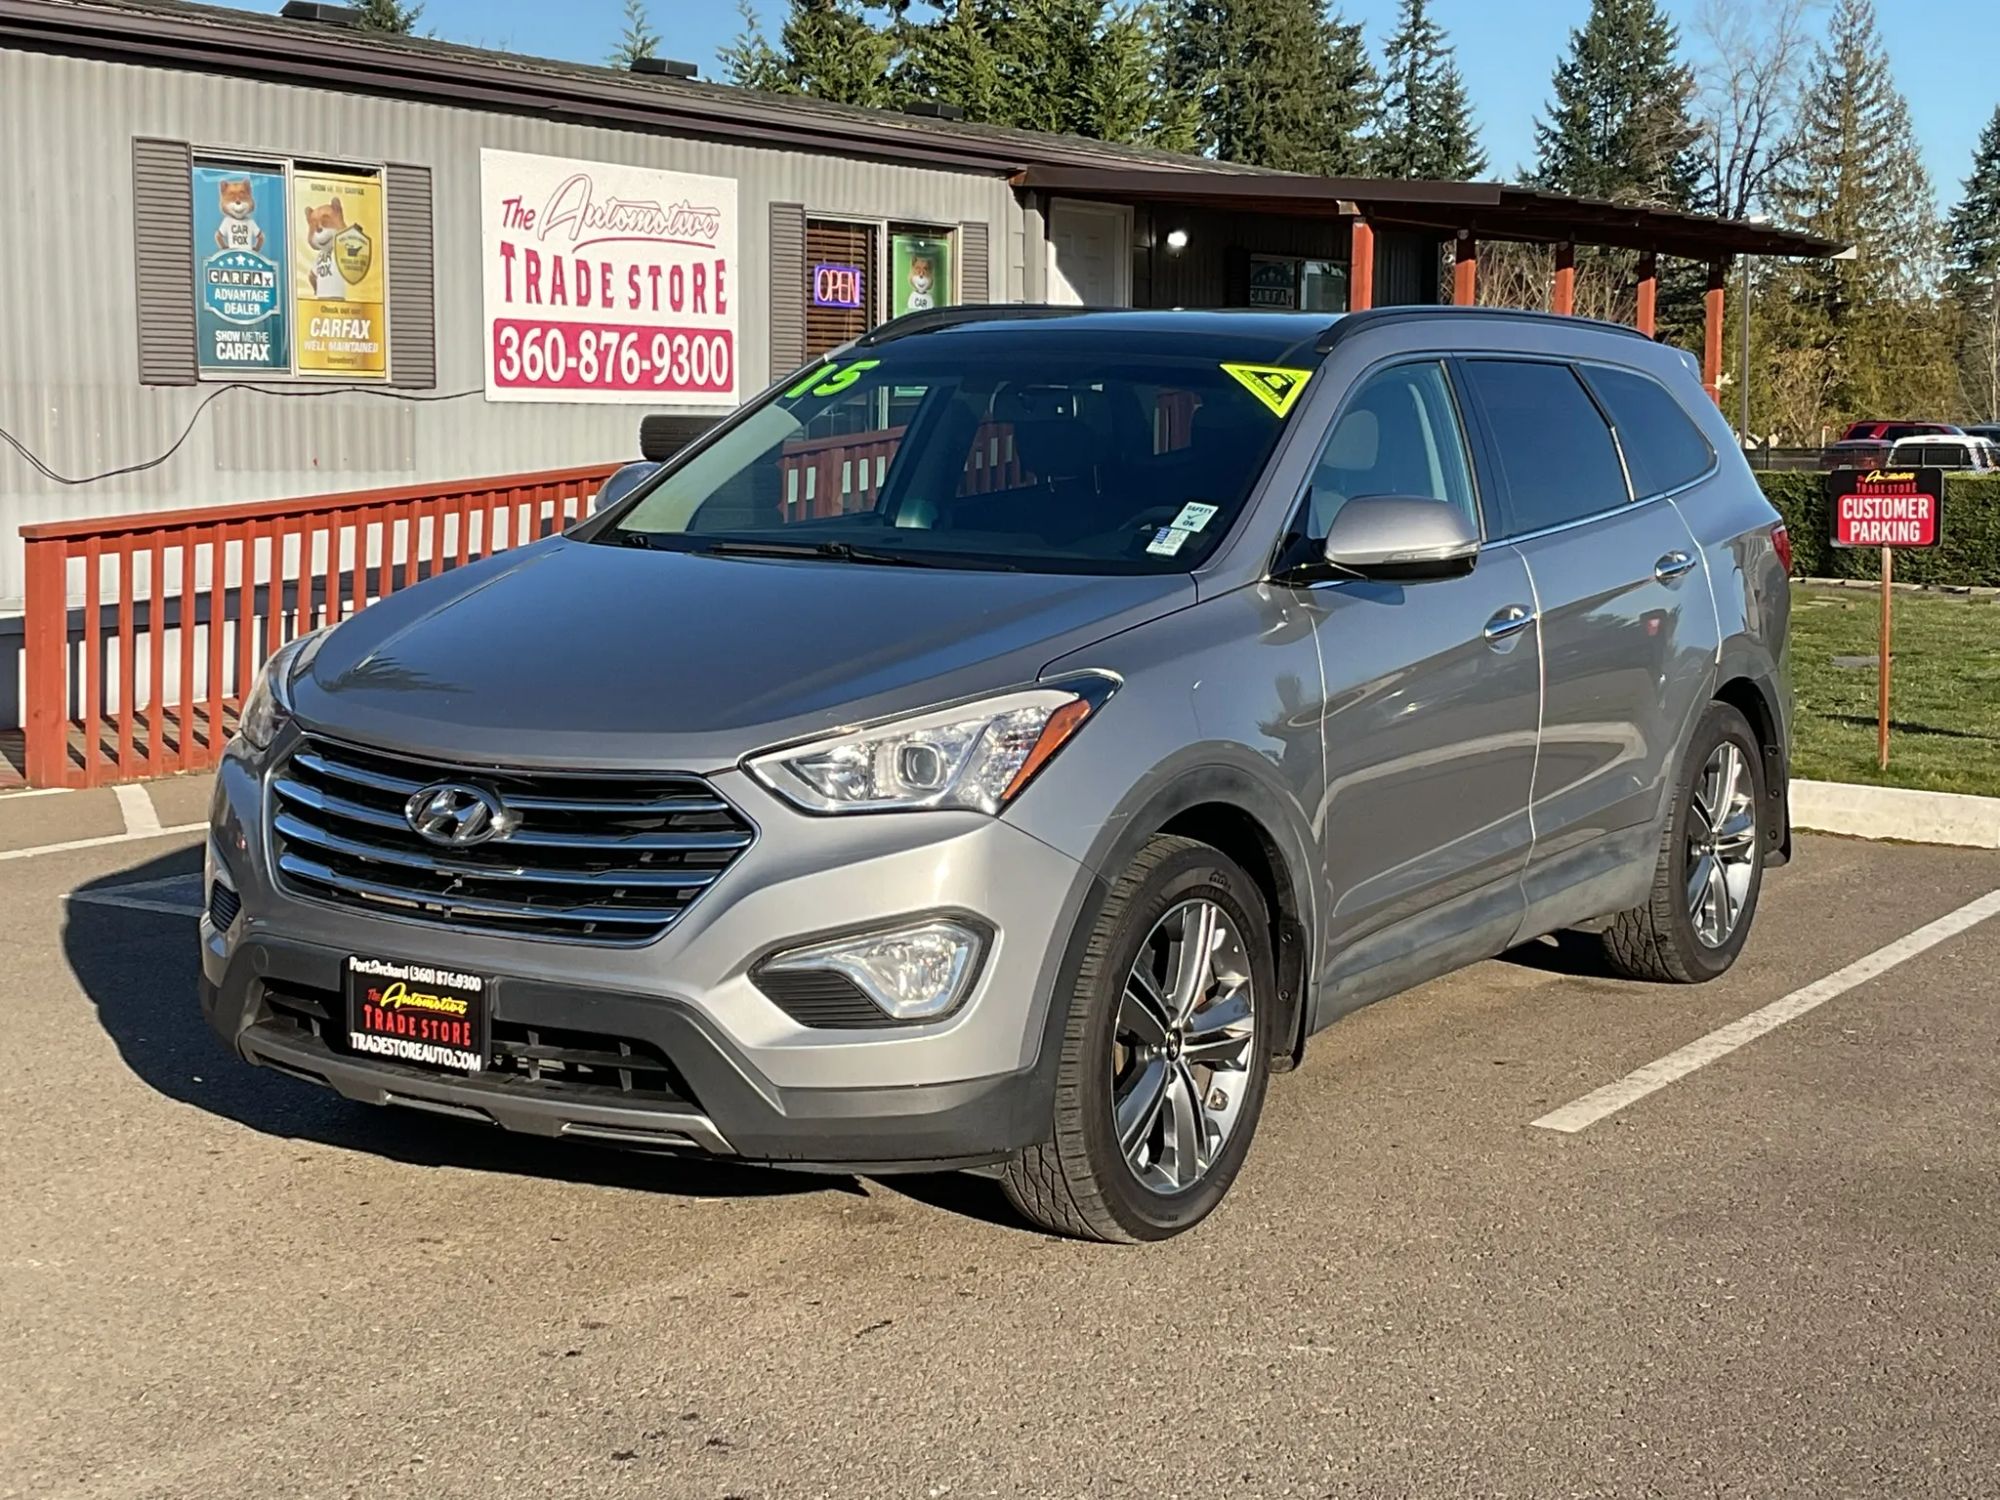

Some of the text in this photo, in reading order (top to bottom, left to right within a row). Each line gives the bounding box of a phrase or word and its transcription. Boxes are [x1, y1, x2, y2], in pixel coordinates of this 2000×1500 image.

[501, 173, 721, 241] The Automotive
[231, 224, 249, 234] CAR
[232, 235, 249, 245] FOX
[210, 270, 273, 287] CARFAX
[500, 240, 727, 315] TRADE STORE
[817, 269, 859, 303] OPEN
[214, 288, 270, 302] ADVANTAGE
[224, 302, 261, 315] DEALER
[215, 330, 269, 343] SHOW ME THE
[310, 317, 371, 339] CARFAX
[216, 342, 271, 361] CARFAX
[304, 340, 379, 353] WELL MAINTAINED
[499, 326, 729, 386] 360-876-9300
[784, 360, 881, 398] 15
[1856, 482, 1917, 494] TRADE STORE
[1186, 505, 1213, 514] SAFETY
[1842, 498, 1929, 519] CUSTOMER
[1850, 521, 1921, 542] PARKING
[349, 956, 371, 973] Port
[409, 965, 435, 985] (360)
[380, 982, 468, 1015] Automotive
[364, 1004, 471, 1046] TRADE STORE
[350, 1031, 482, 1072] TRADESTOREAUTO.COM
